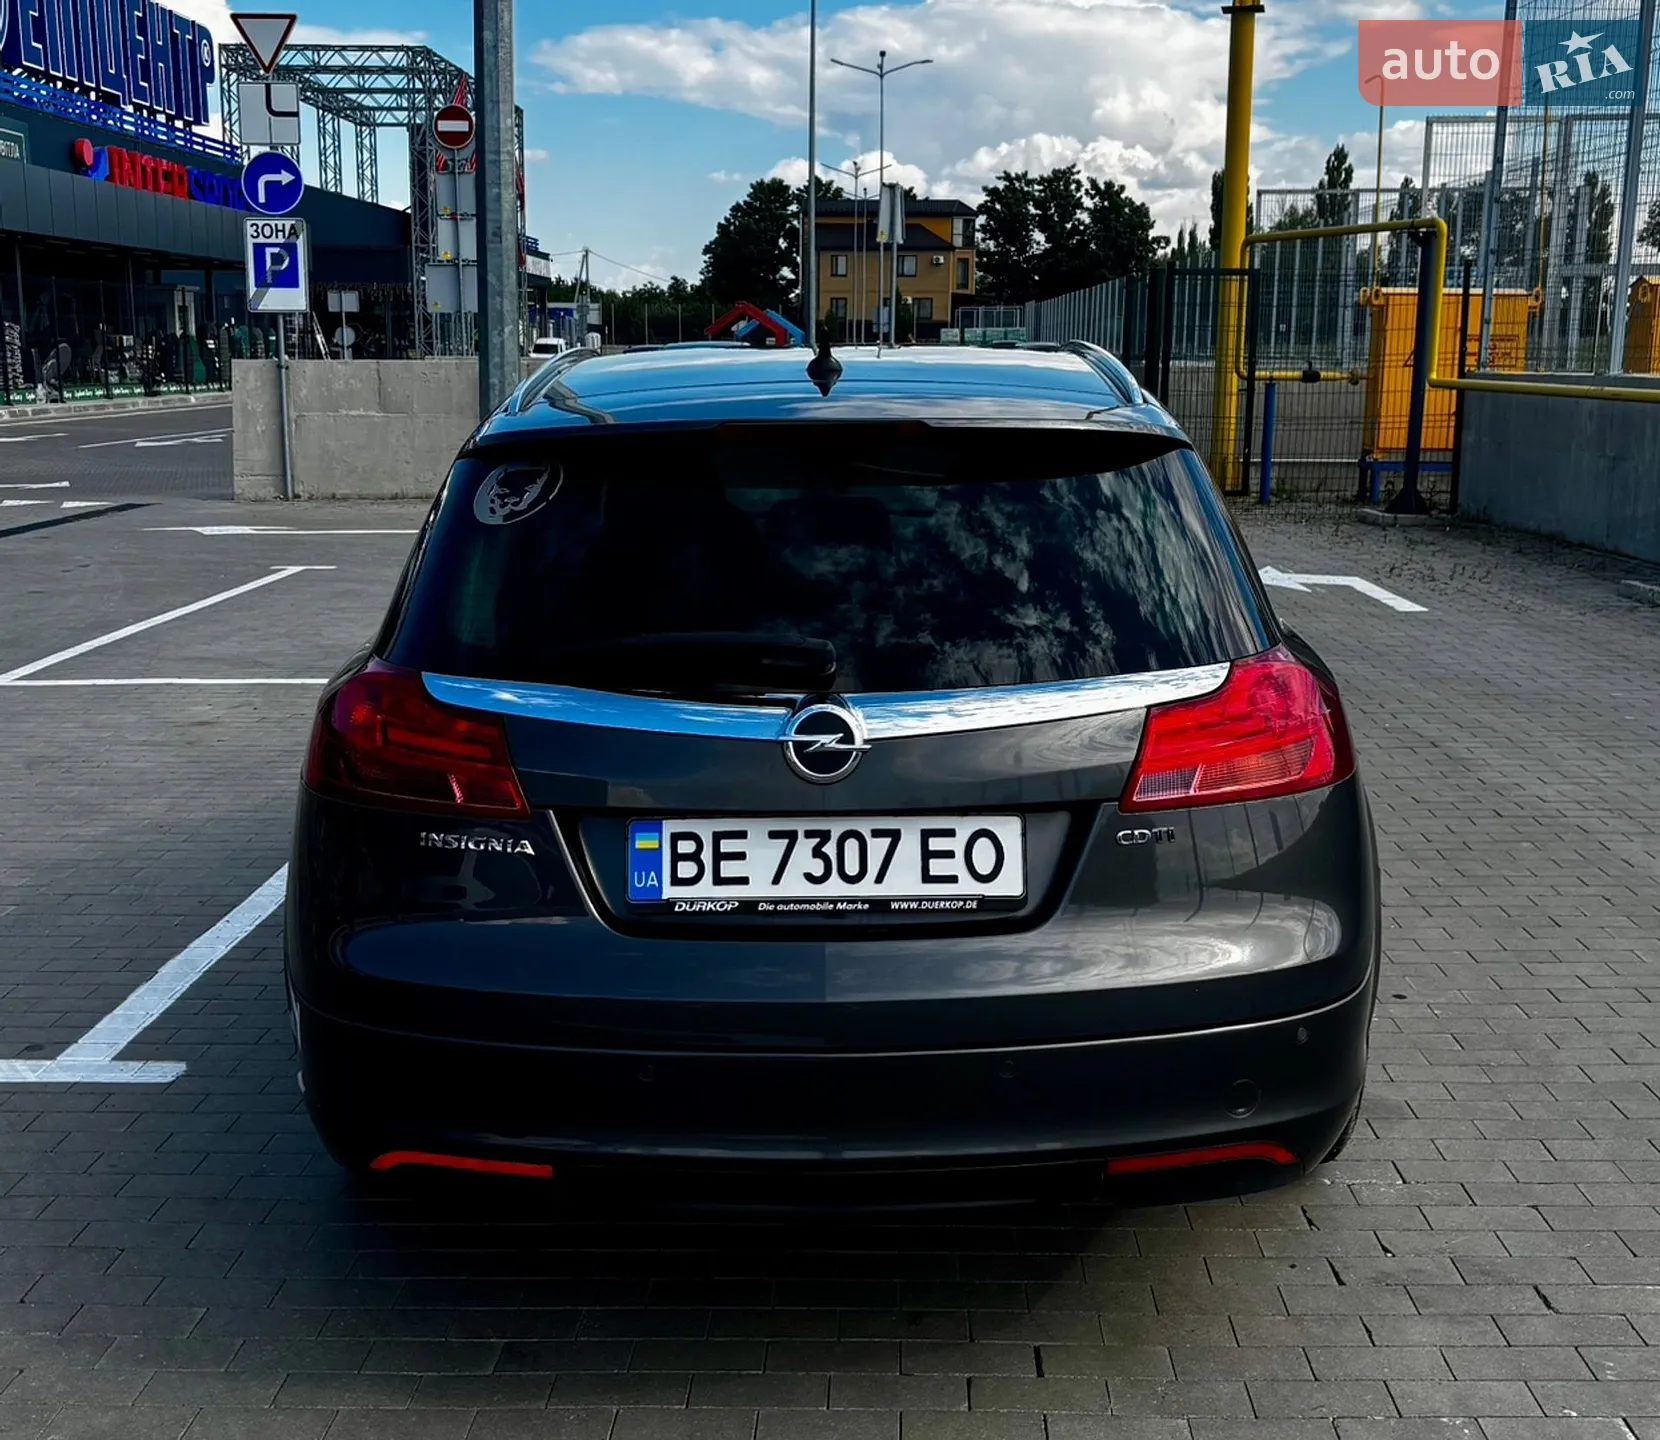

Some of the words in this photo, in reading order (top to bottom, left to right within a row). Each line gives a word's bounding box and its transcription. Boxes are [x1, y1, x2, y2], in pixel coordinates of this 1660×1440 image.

[250, 223, 300, 239] ЗОНА
[420, 832, 535, 855] INSIGNIA
[669, 829, 750, 887] BE
[767, 829, 902, 886] 7307
[920, 828, 1005, 885] EO
[634, 871, 659, 888] UA
[758, 902, 775, 911] Die
[776, 902, 834, 911] automobile
[836, 902, 869, 911] Marke
[891, 900, 978, 910] WWW.DUERKOP.DE
